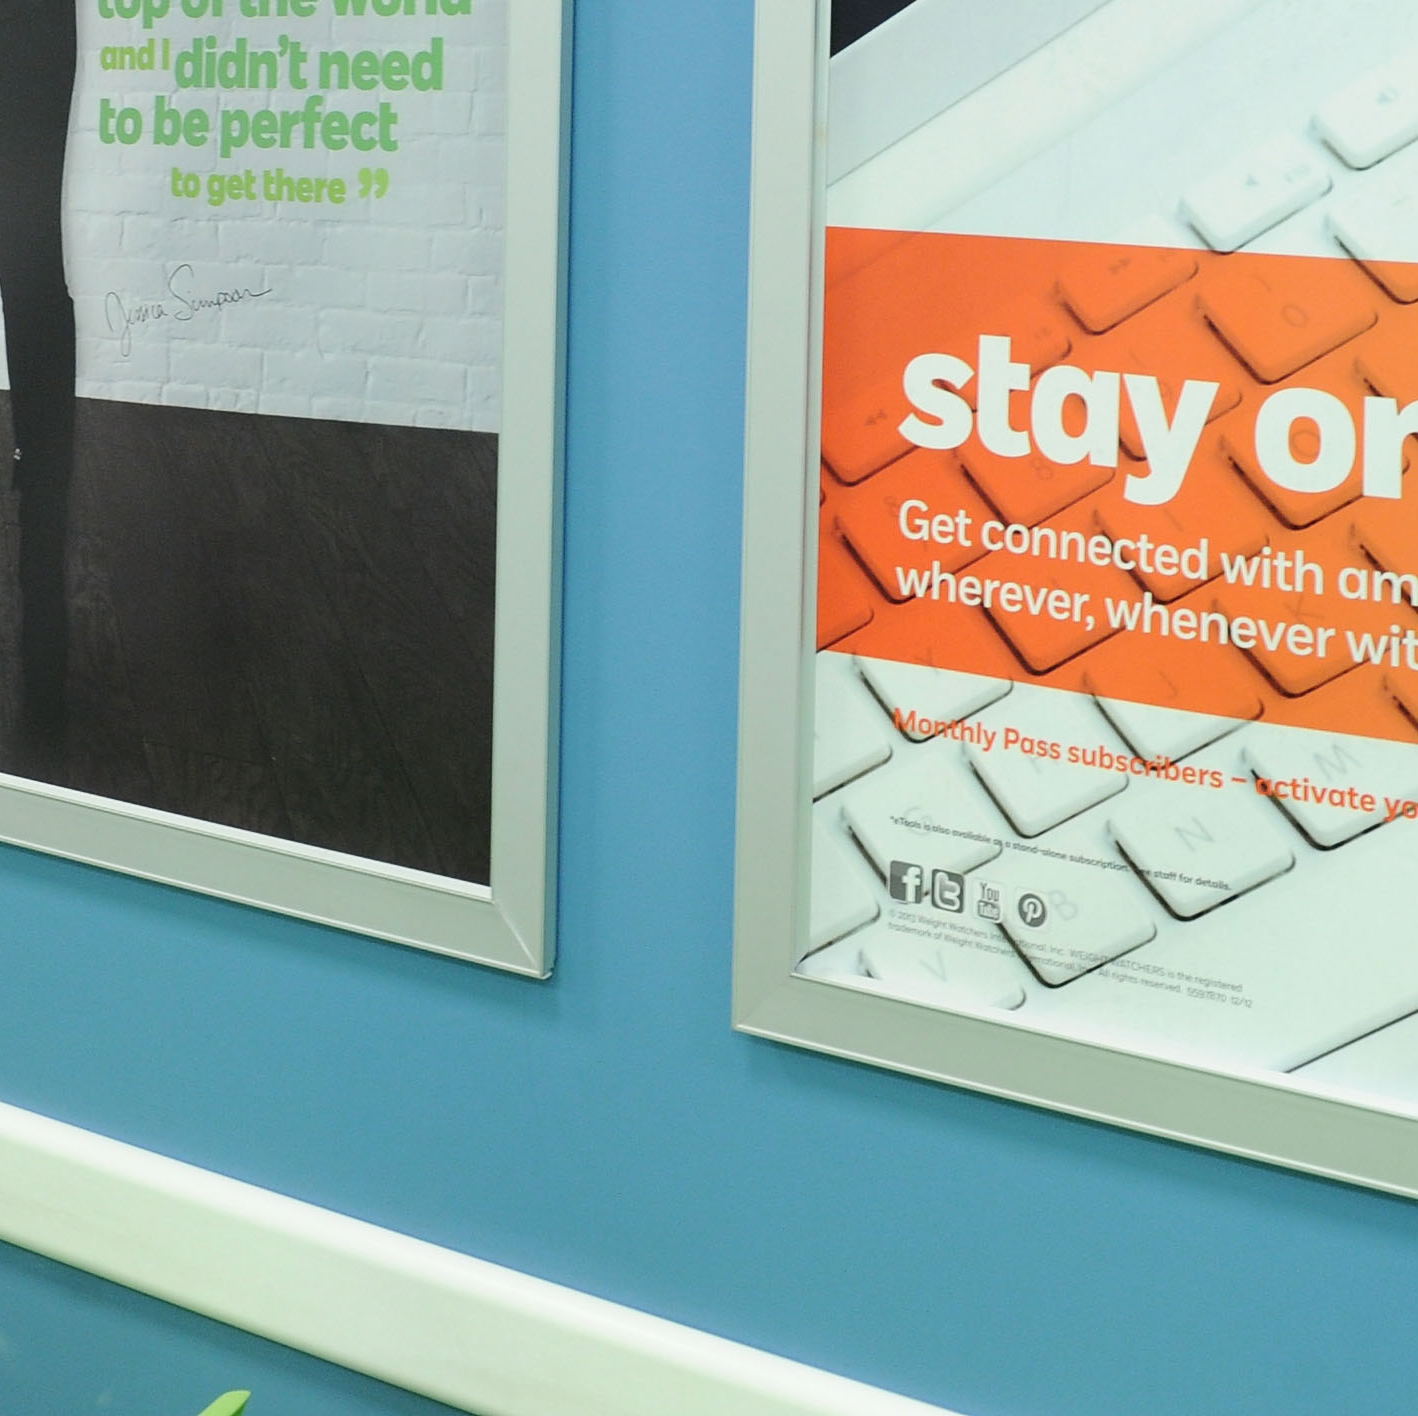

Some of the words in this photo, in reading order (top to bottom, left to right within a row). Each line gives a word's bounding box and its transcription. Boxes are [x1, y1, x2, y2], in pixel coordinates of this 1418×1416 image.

[100, 37, 156, 71] and
[161, 38, 171, 71] I
[174, 34, 309, 90] didn't
[318, 37, 444, 91] need
[98, 98, 143, 145] to
[153, 95, 210, 148] be
[220, 94, 400, 159] perfect
[170, 167, 201, 198] to
[206, 169, 257, 206] get
[262, 168, 347, 204] there
[898, 334, 1220, 506] stay
[898, 499, 973, 544] Get
[980, 513, 1209, 582] connected
[1221, 548, 1326, 596] with
[896, 561, 1096, 632] wherever,
[1105, 593, 1334, 659] whenever
[893, 707, 997, 752] Monthly
[1004, 727, 1061, 760] Pass
[1067, 744, 1224, 789] subscribers
[1255, 773, 1376, 812] activate
